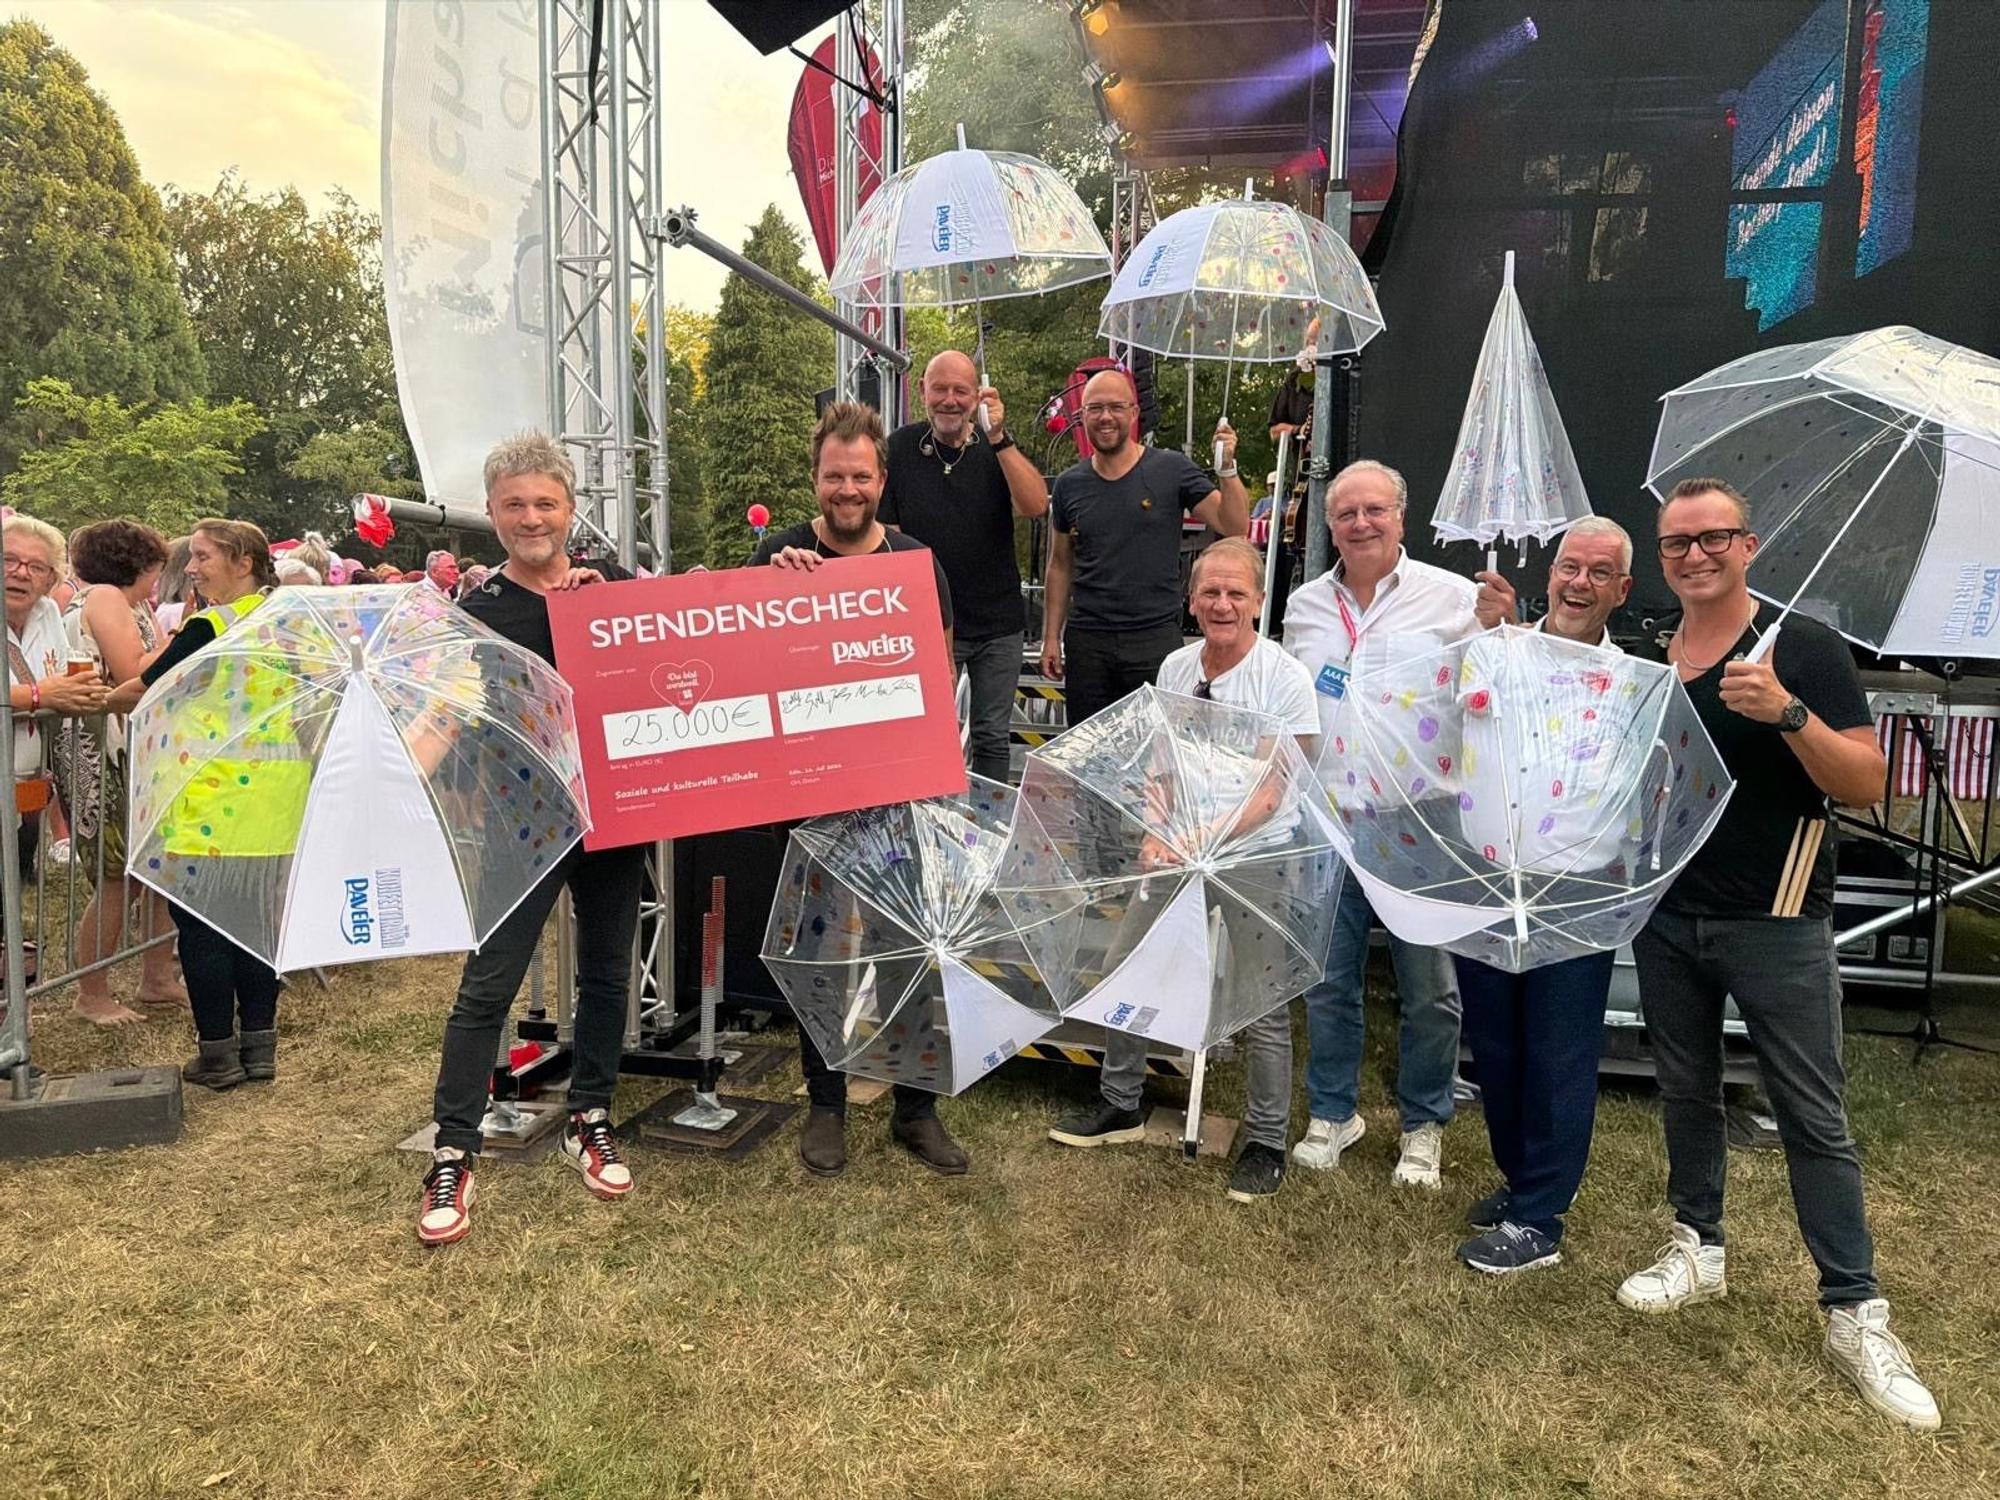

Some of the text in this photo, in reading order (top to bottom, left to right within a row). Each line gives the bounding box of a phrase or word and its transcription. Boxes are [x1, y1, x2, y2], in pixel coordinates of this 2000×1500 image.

[589, 586, 909, 648] SPENDENSCHECK
[622, 700, 760, 747] 25.000€
[615, 770, 759, 800] Soziale und kulturelle Teilhabe
